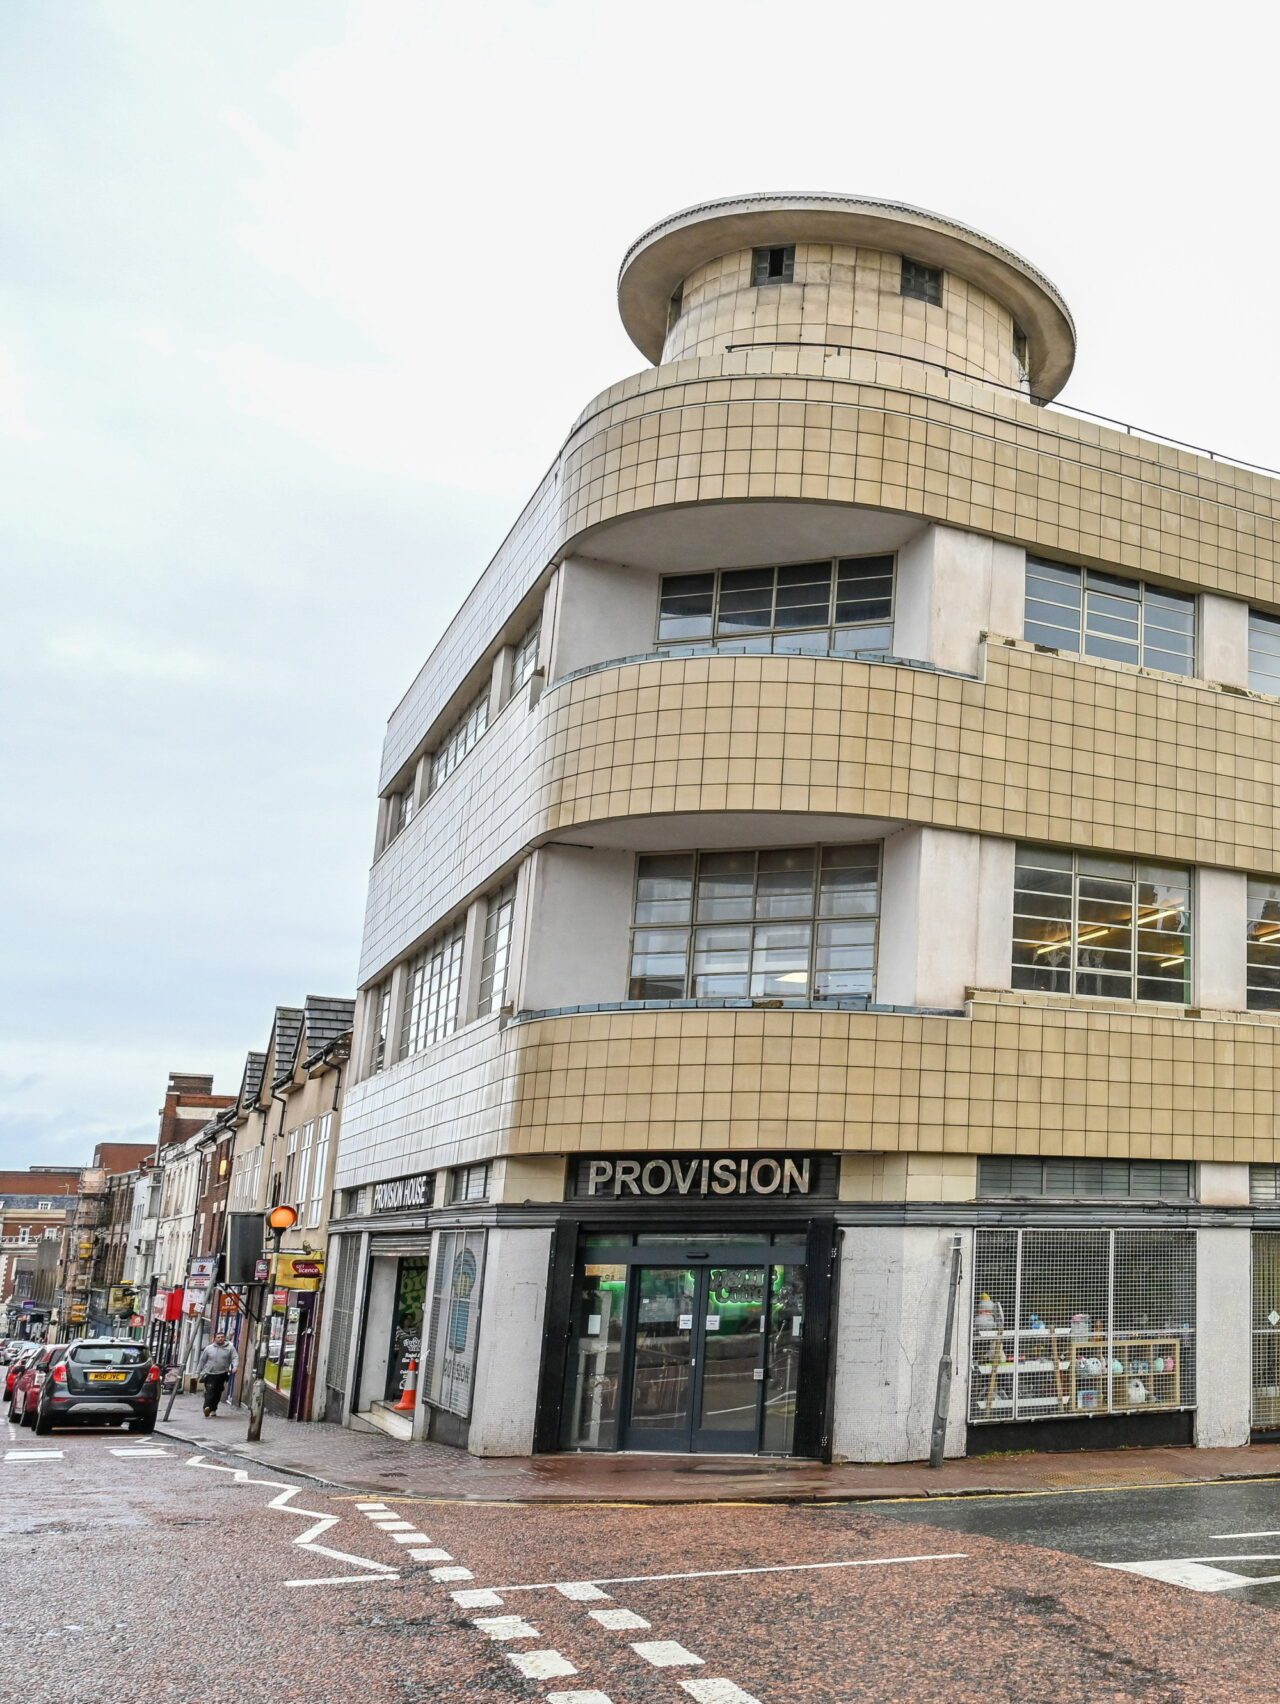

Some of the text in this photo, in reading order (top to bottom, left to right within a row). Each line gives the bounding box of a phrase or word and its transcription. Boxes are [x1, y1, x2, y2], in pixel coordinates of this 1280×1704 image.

[373, 1175, 427, 1209] PROVISION HOUSE
[588, 1158, 811, 1195] PROVISION
